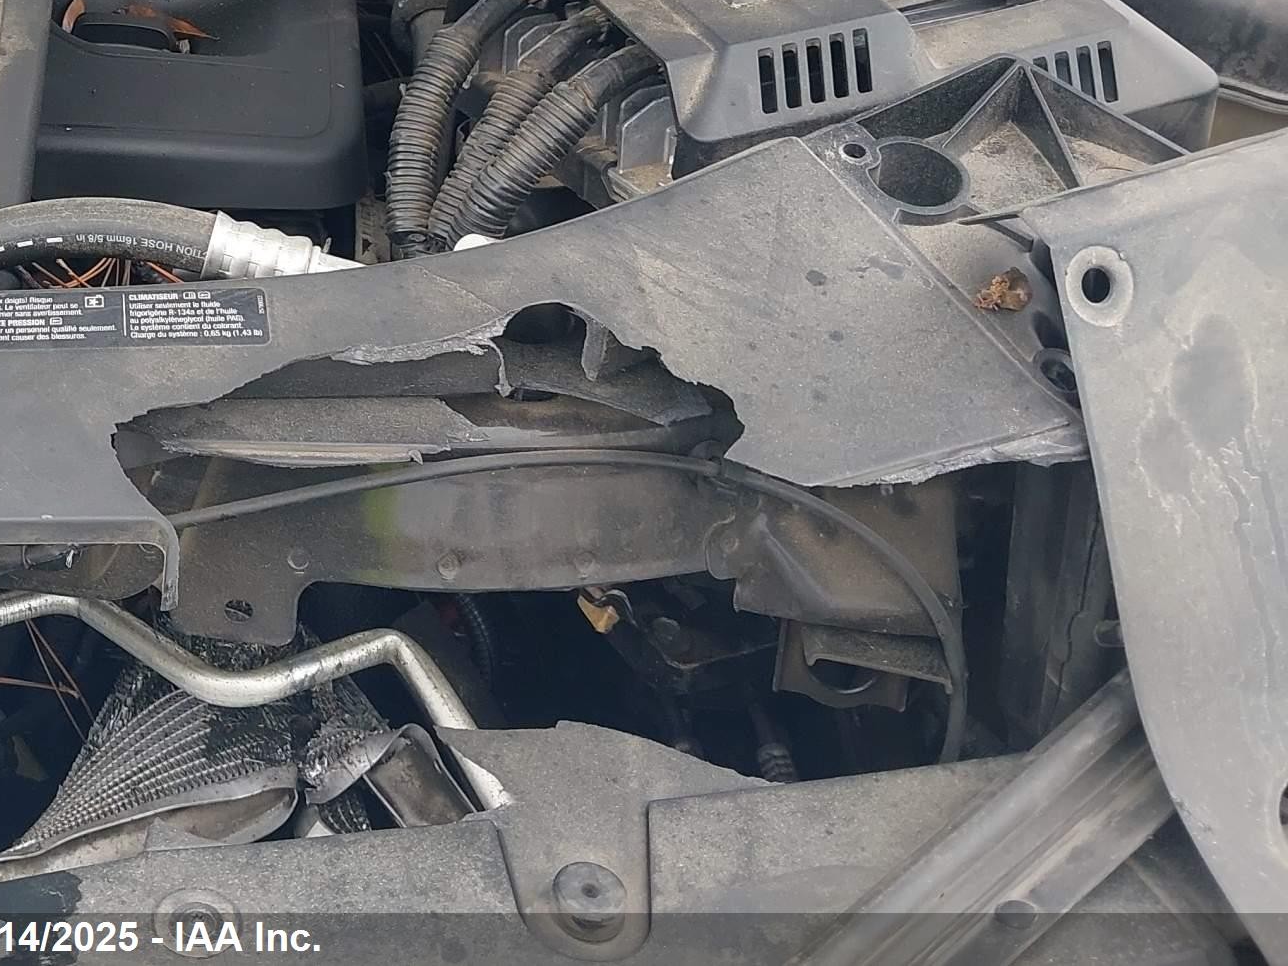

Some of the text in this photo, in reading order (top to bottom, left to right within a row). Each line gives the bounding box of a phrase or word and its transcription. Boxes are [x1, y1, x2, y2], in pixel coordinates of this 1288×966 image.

[76, 234, 85, 243] in
[88, 233, 103, 243] 5/8
[107, 234, 137, 246] 16mm
[140, 238, 173, 251] HOSE
[129, 293, 178, 301] CLIMATISEUR
[129, 302, 153, 310] Utiliser
[130, 309, 167, 317] frigorigène
[8, 319, 45, 327] PRESSION
[141, 324, 170, 332] système
[130, 331, 155, 339] Charge
[222, 330, 231, 338] kg
